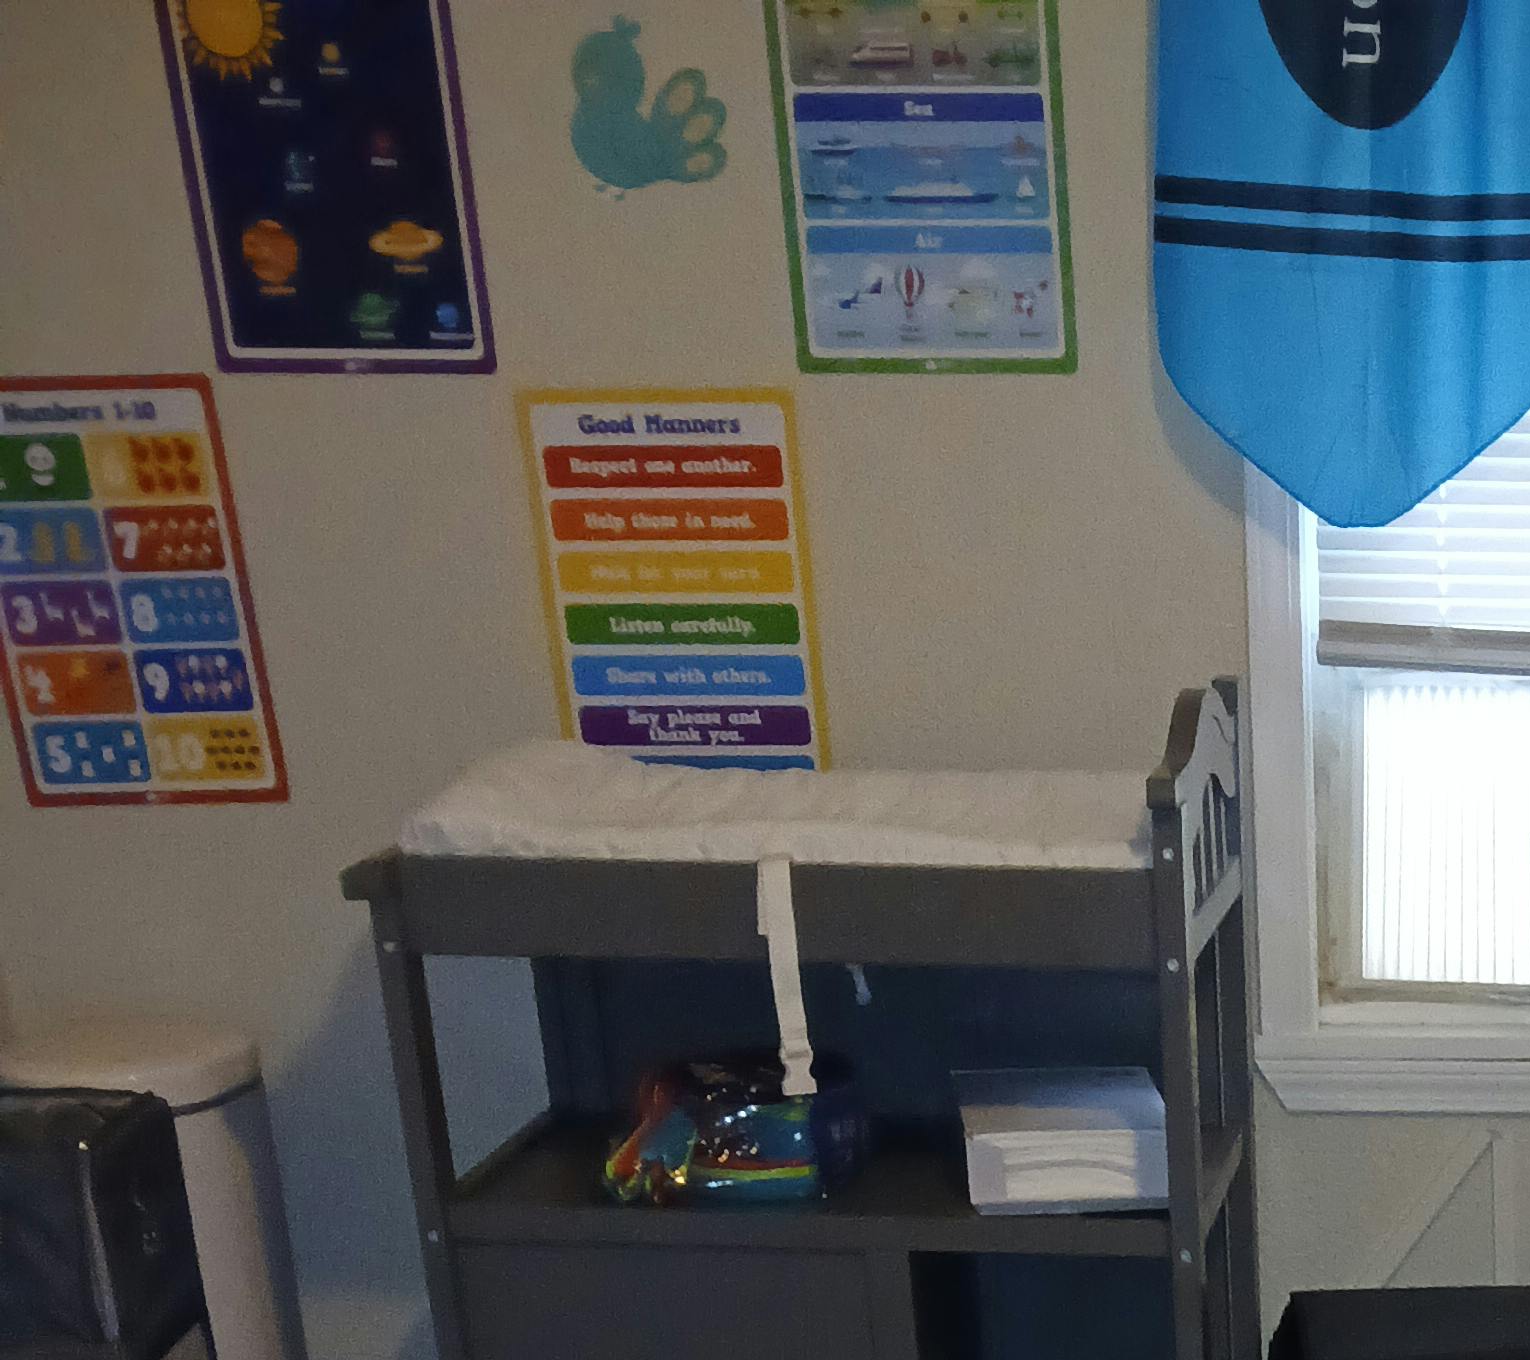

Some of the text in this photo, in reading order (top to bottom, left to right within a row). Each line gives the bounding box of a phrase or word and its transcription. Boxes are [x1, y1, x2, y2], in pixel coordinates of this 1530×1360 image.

[578, 413, 741, 435] Good Manners
[113, 521, 140, 560] 7
[11, 594, 38, 635] 3
[131, 593, 159, 632] 8
[23, 664, 56, 705] 4
[143, 662, 170, 701] 9
[664, 666, 706, 684] with
[627, 709, 762, 729] Say please and
[708, 729, 745, 746] you.
[45, 735, 72, 773] 5
[153, 731, 206, 771] 10
